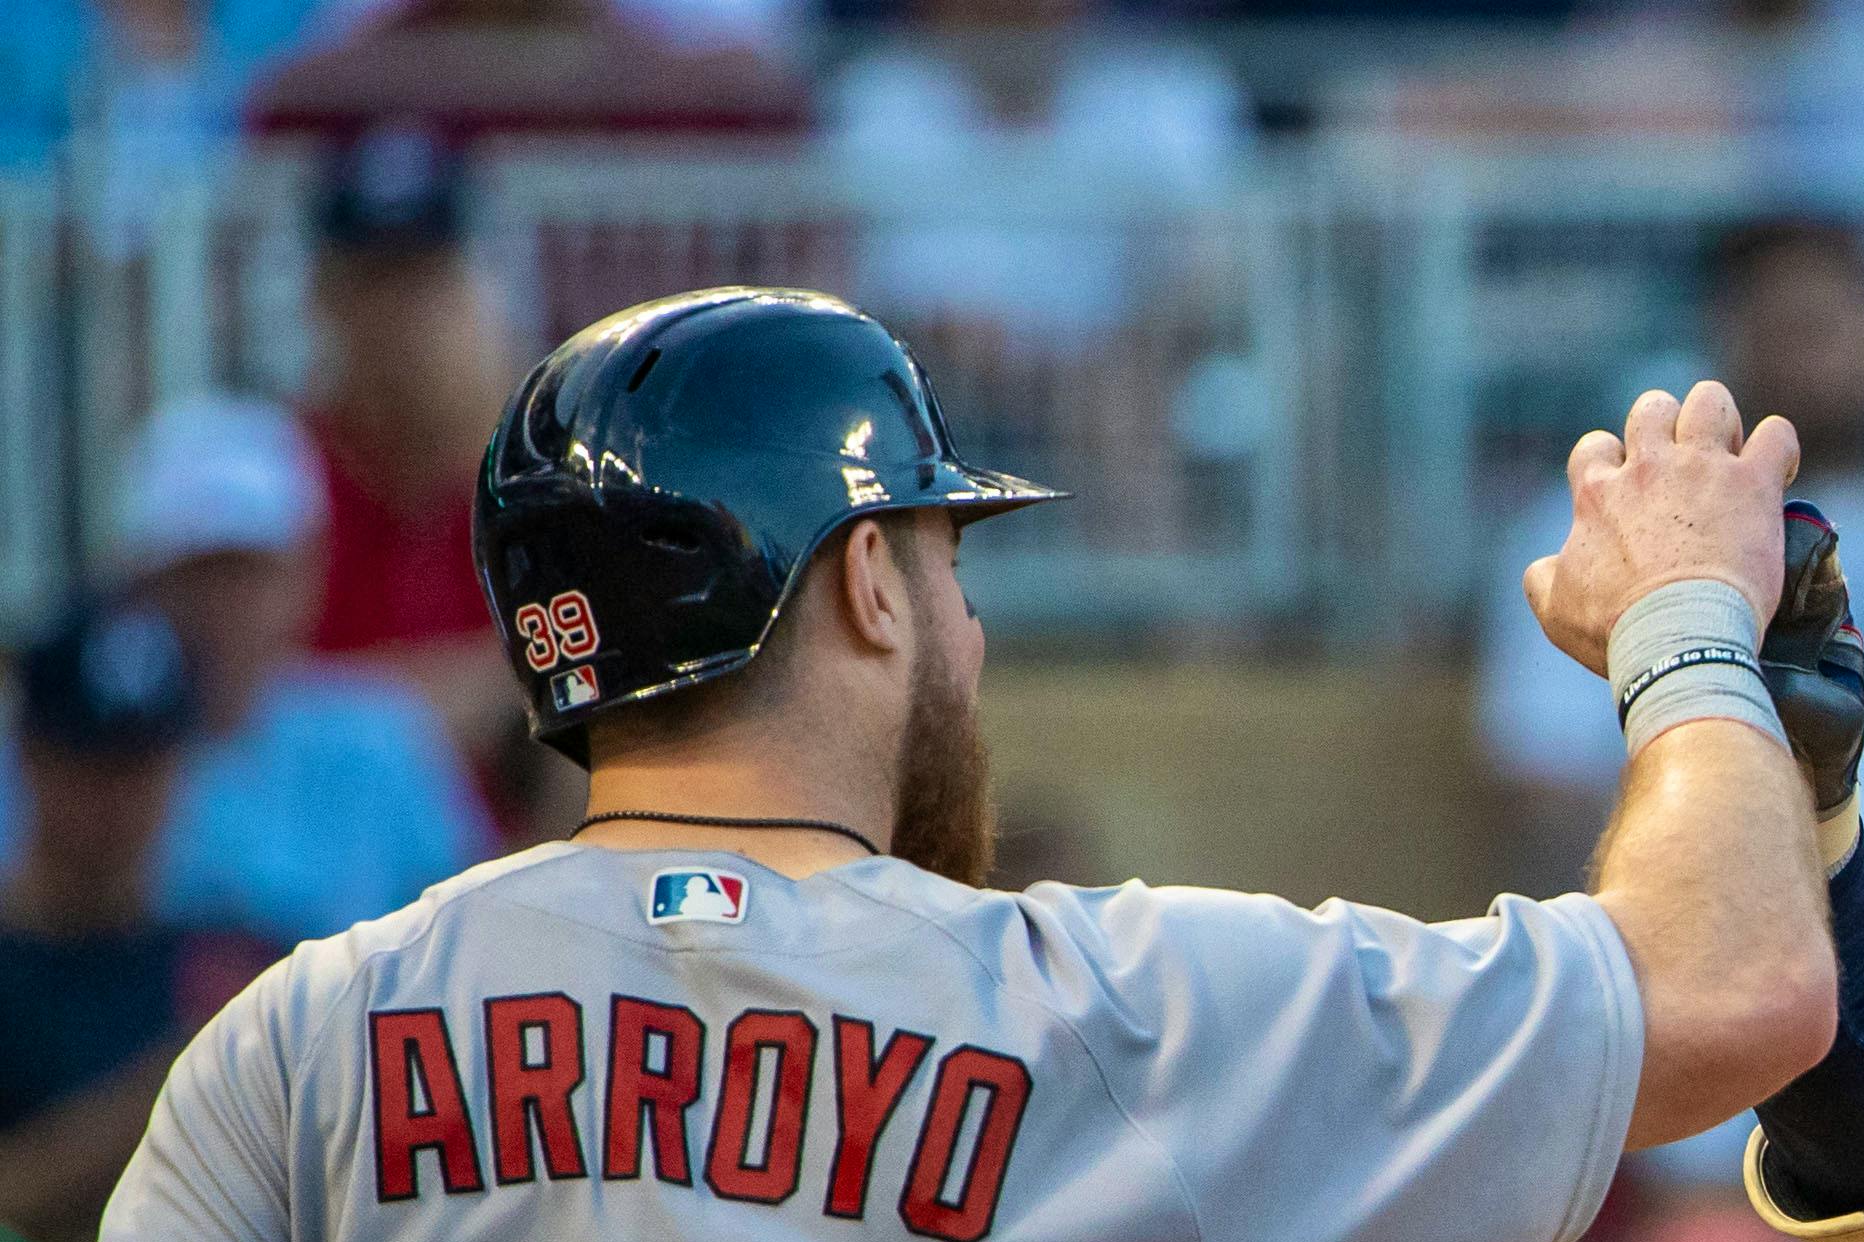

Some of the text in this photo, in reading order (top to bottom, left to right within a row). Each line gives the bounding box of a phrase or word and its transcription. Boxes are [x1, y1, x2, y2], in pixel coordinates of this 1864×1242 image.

[516, 590, 600, 673] 39
[1651, 655, 1680, 676] life
[1683, 652, 1701, 662] to
[1704, 648, 1732, 660] the
